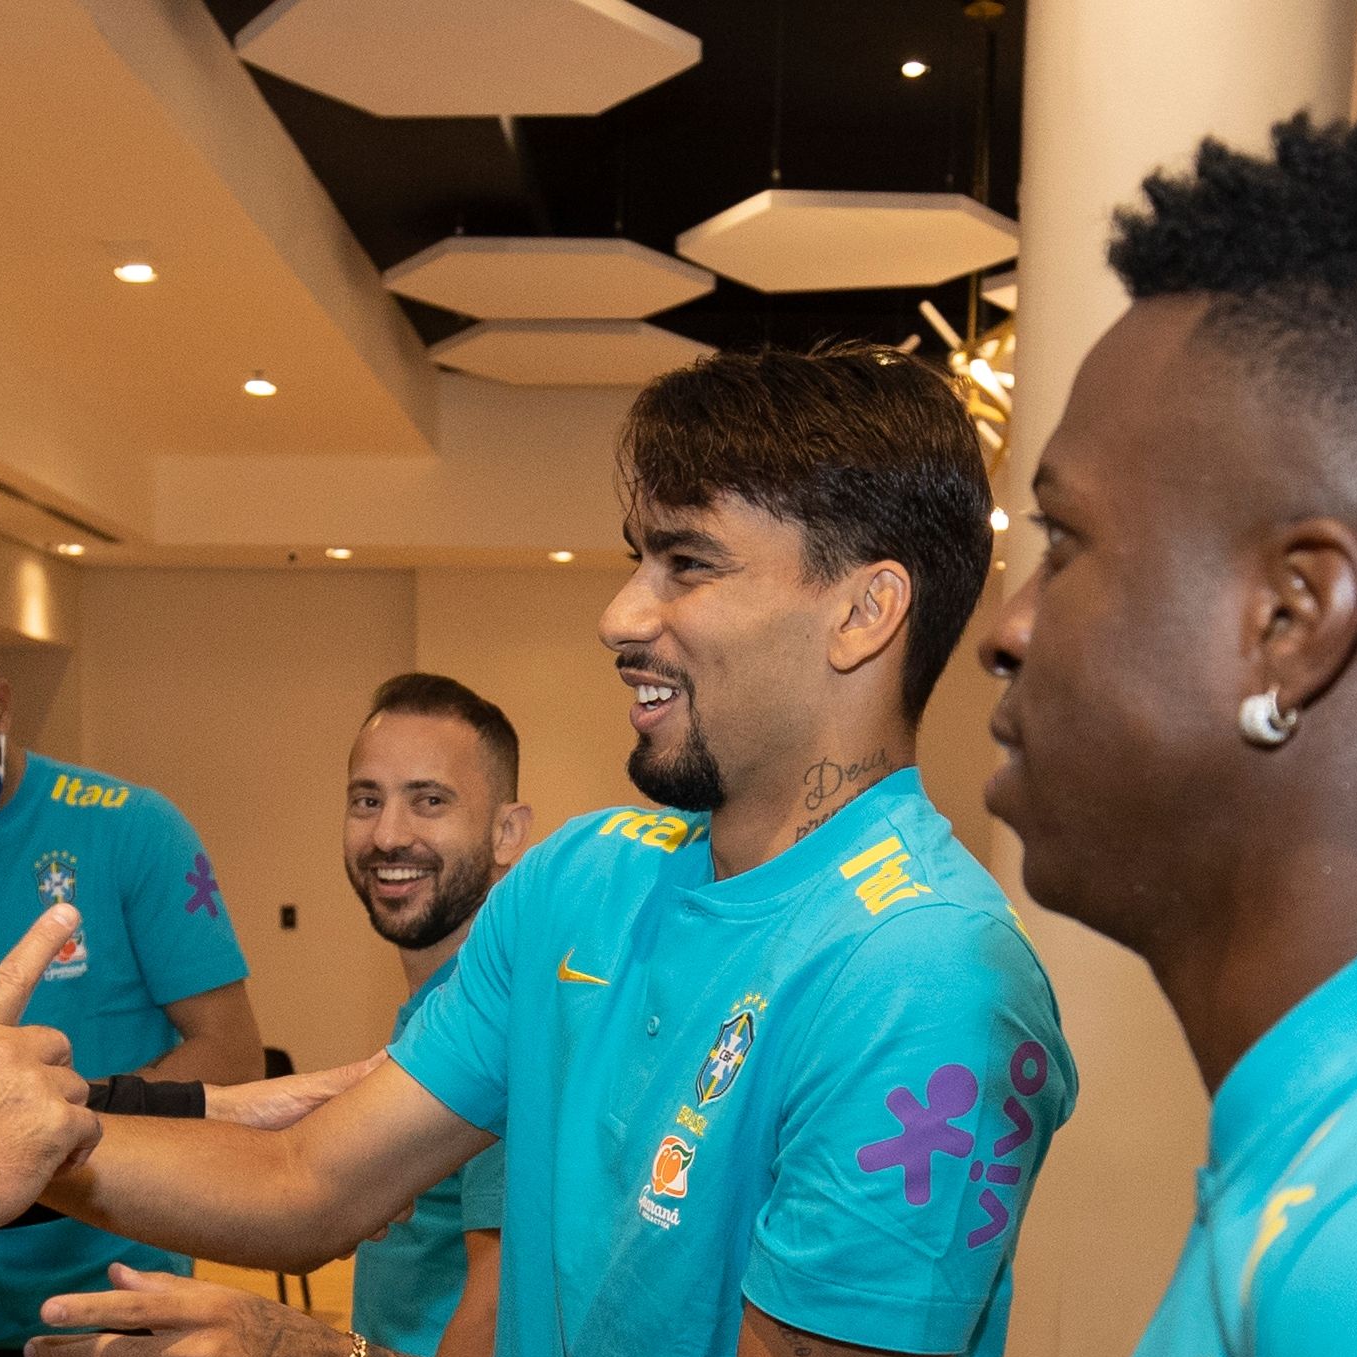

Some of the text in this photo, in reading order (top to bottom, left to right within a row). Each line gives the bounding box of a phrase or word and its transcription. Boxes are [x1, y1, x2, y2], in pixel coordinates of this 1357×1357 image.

[51, 774, 130, 808] Itaú
[598, 810, 705, 853] Ita
[966, 1039, 1048, 1249] vivo
